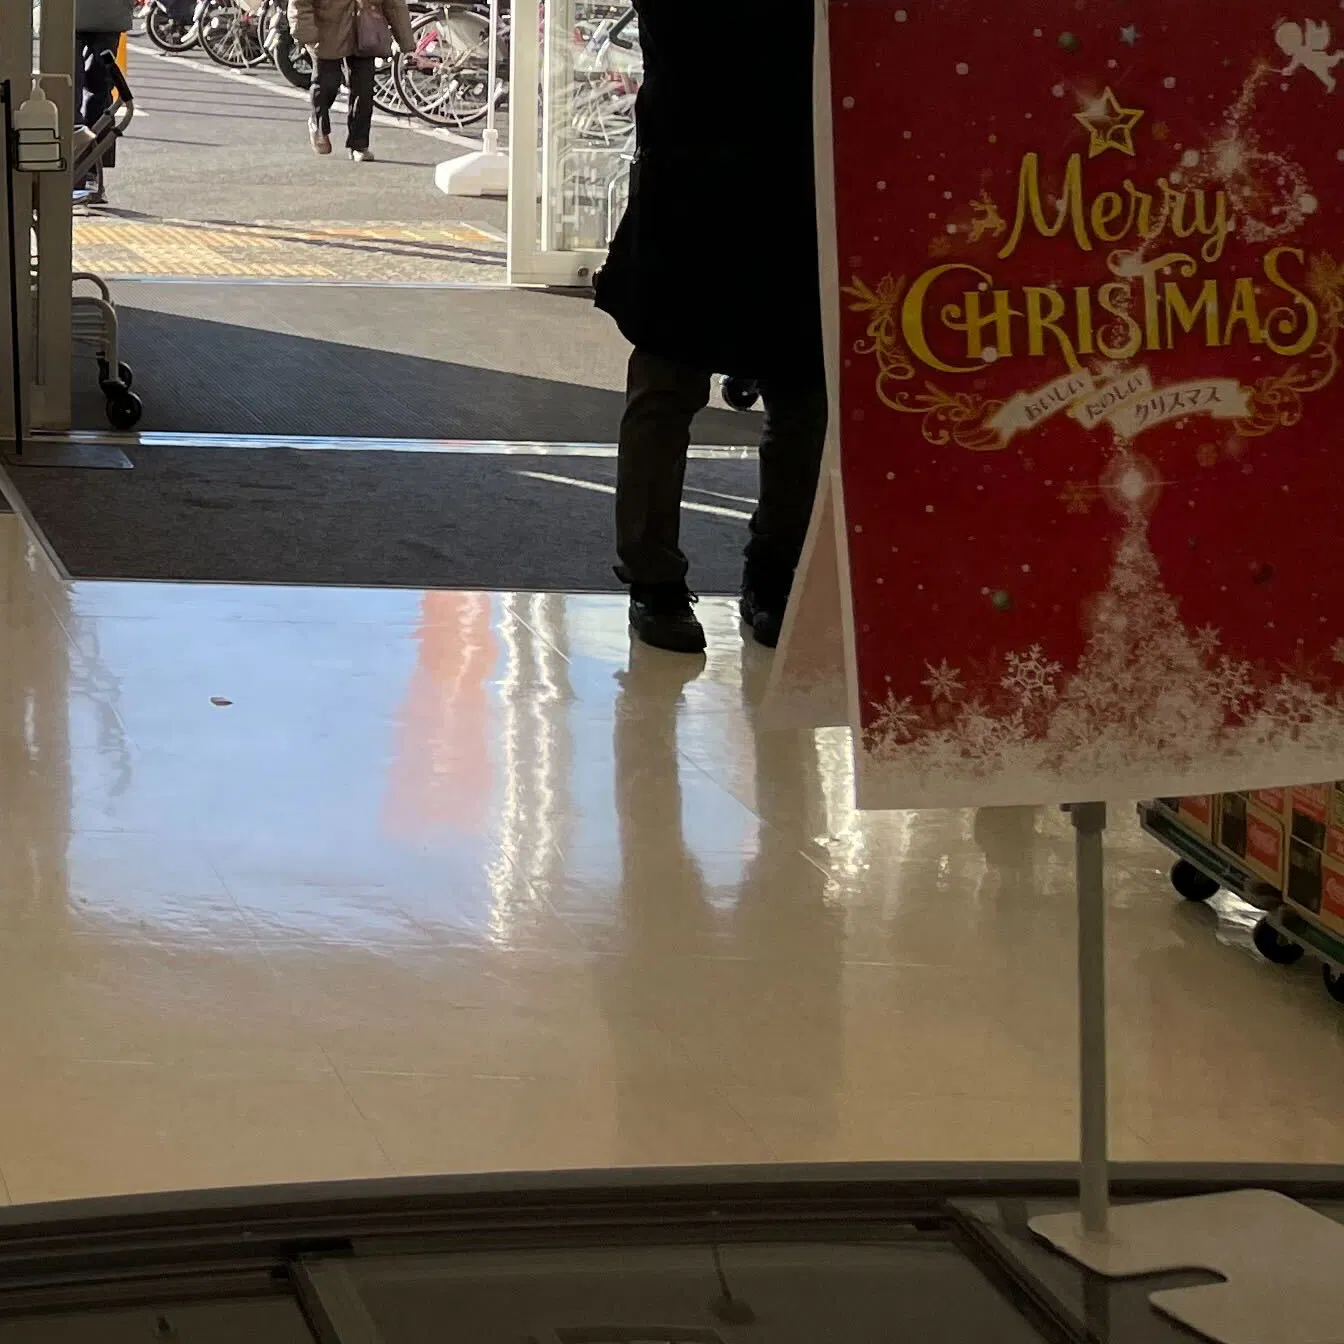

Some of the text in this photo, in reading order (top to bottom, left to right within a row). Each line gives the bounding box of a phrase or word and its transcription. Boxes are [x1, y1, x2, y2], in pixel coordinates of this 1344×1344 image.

[998, 152, 1231, 262] Merry
[901, 247, 1318, 374] CHRISTMAS
[1024, 378, 1085, 421] おいしい
[1134, 386, 1222, 423] クリスマス
